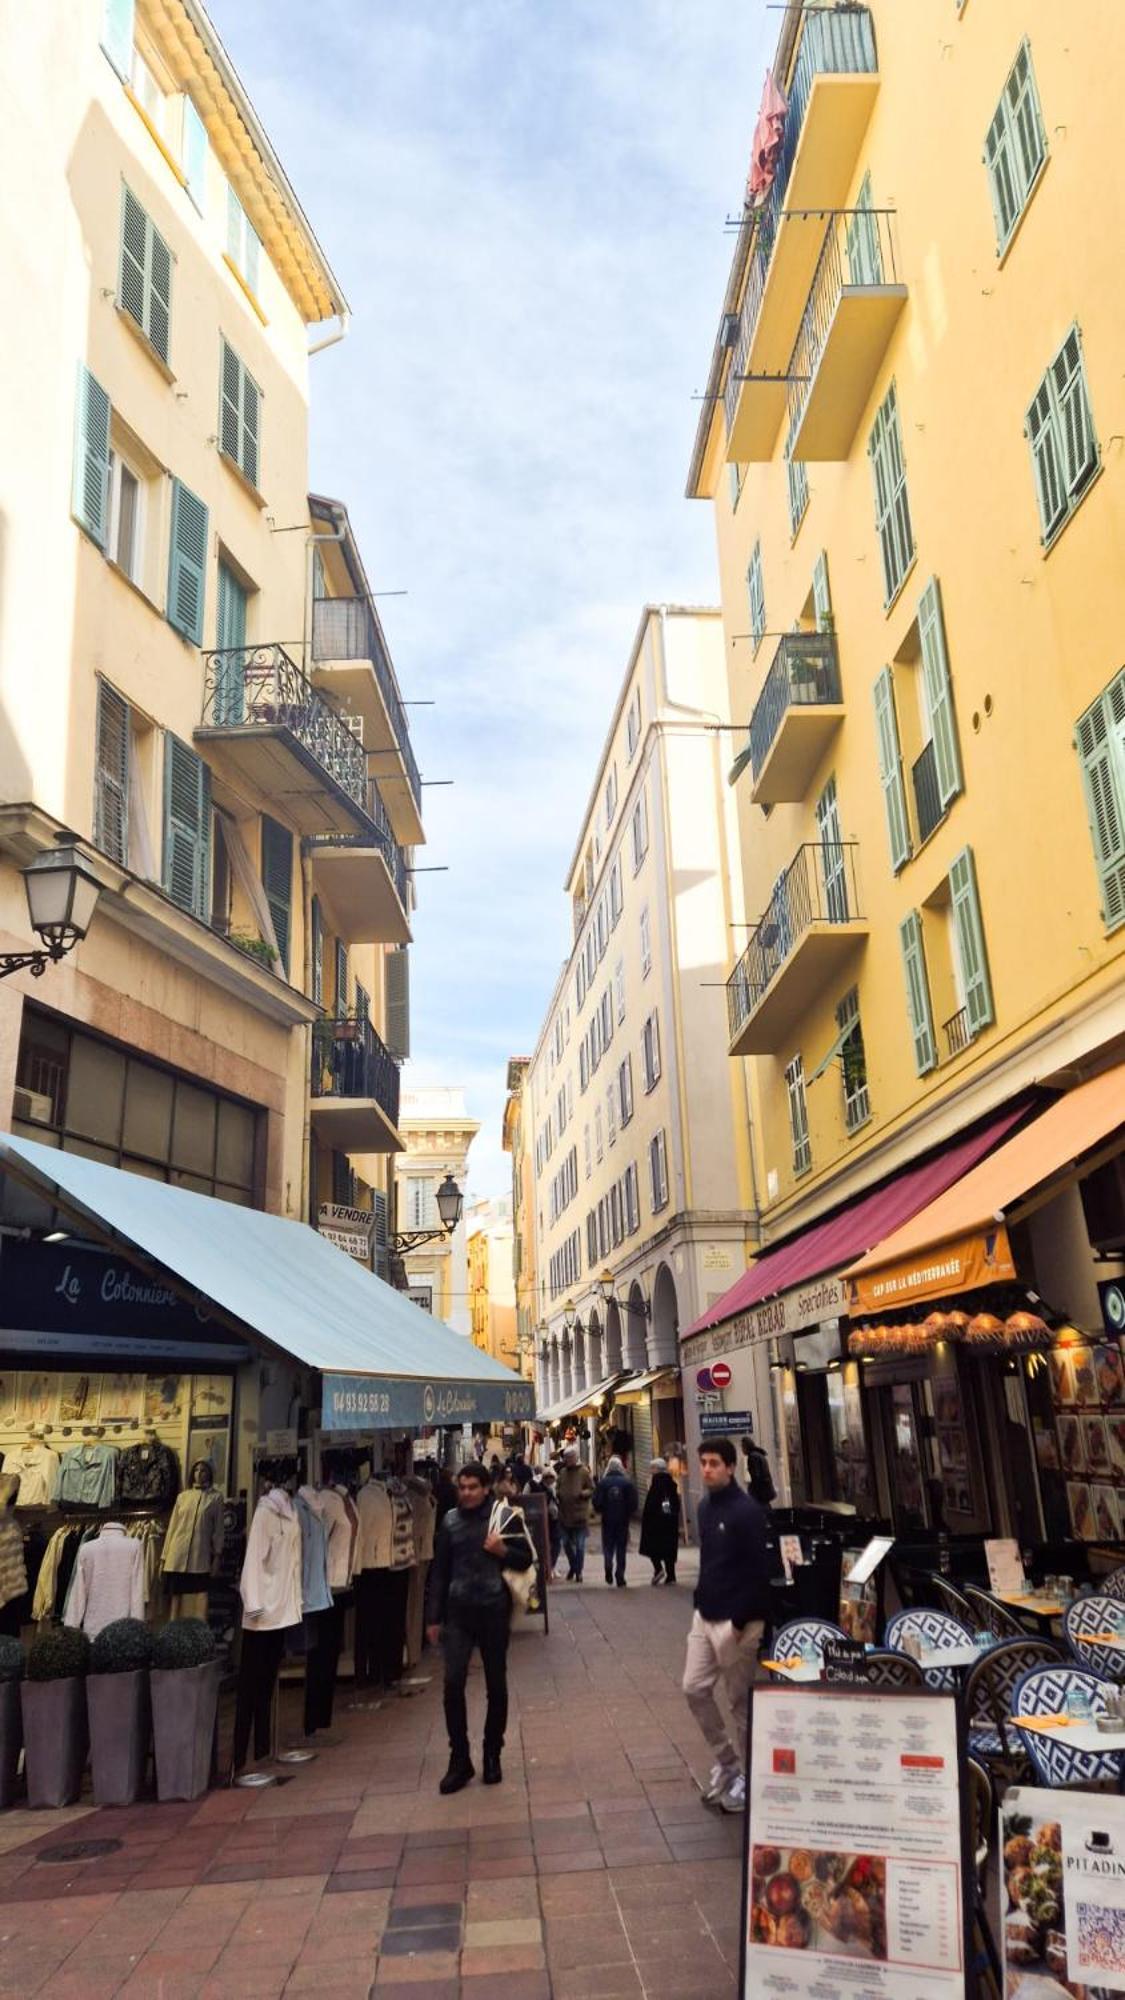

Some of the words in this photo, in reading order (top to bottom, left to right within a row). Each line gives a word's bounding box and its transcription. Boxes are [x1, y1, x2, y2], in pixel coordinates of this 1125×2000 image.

[320, 1205, 328, 1216] A
[332, 1206, 374, 1225] VENDRE
[55, 1265, 81, 1304] La
[873, 1283, 885, 1297] CAP
[885, 1279, 897, 1294] SUR
[899, 1276, 907, 1290] LA
